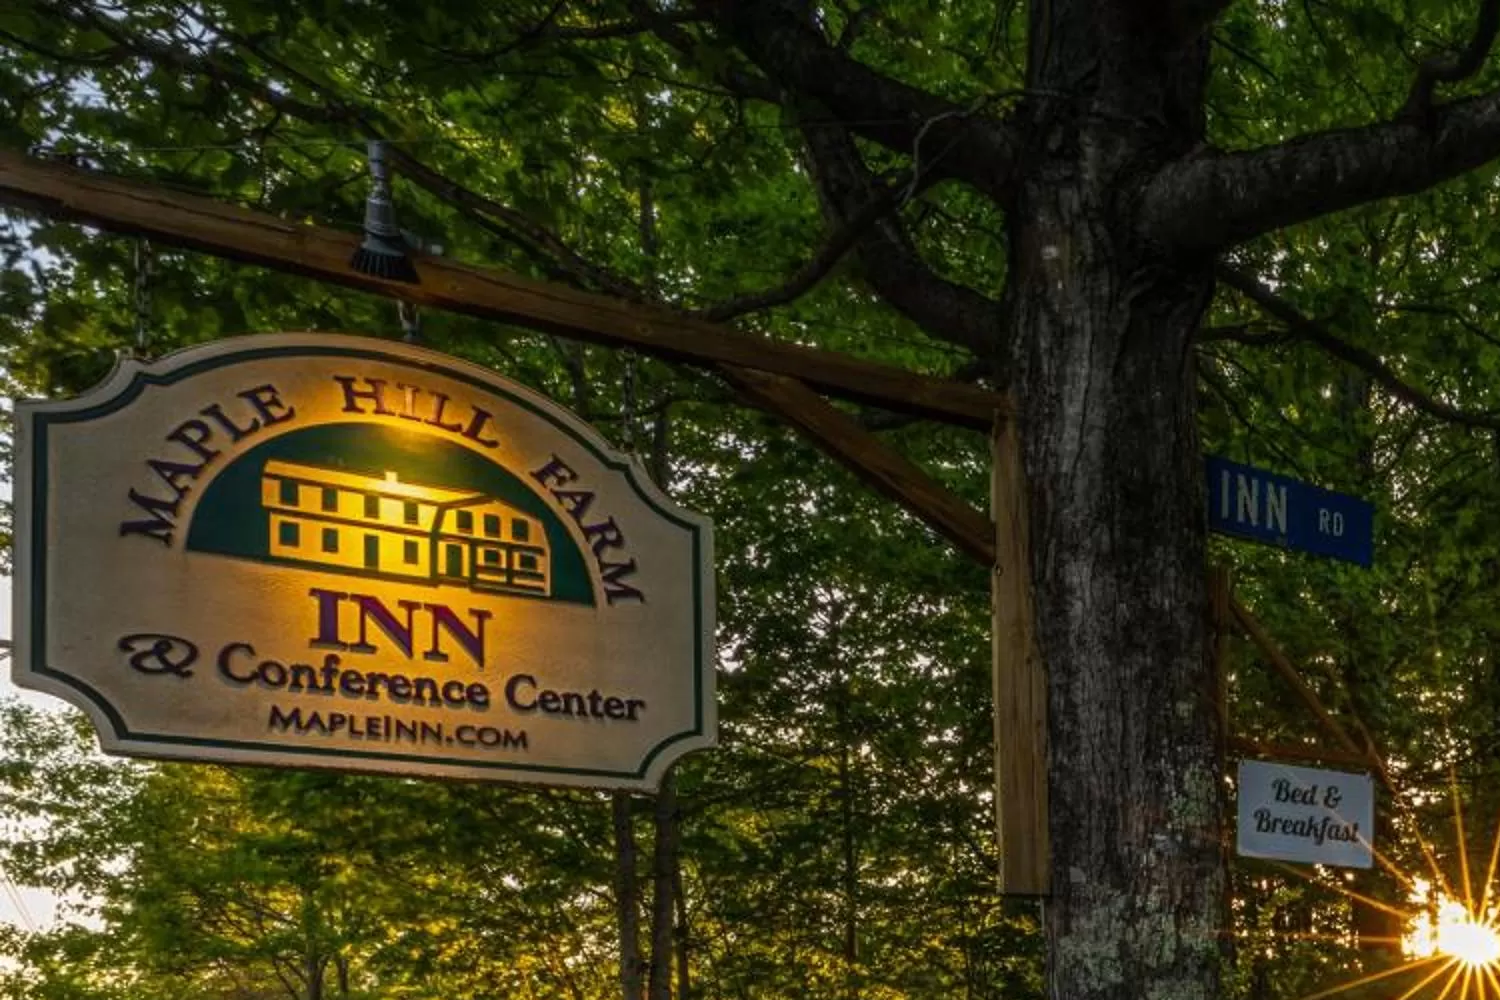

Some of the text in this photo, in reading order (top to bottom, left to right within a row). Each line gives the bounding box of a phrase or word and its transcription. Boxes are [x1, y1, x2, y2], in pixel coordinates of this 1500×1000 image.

[119, 375, 646, 604] MAPLE HILL FARM
[1221, 469, 1344, 537] INN RD
[309, 588, 492, 667] INN
[118, 633, 645, 722] & Conference Center
[1254, 808, 1360, 846] Breakfast
[1272, 778, 1343, 809] Bed &
